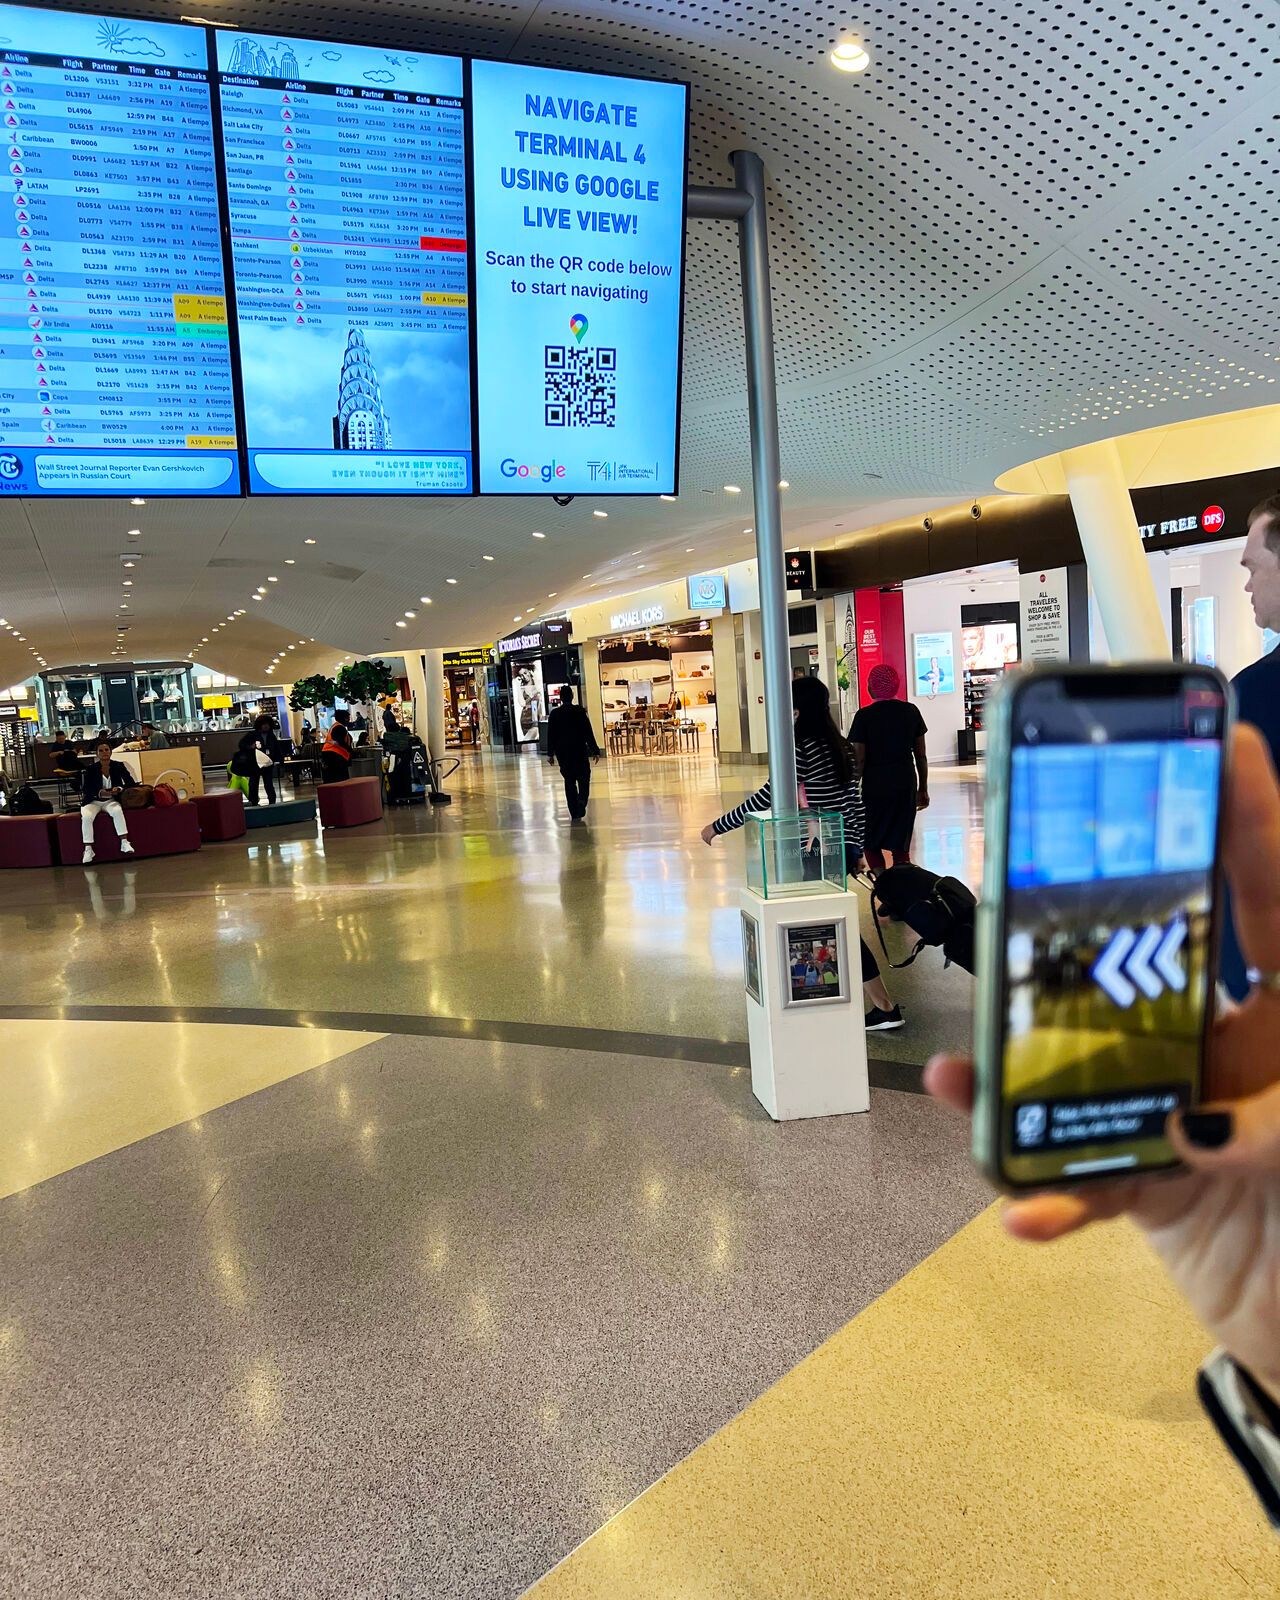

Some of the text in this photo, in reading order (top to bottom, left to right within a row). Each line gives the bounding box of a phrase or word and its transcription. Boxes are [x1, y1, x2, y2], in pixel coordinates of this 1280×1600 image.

[5, 54, 207, 80] Airline Flight Partner Time Gate Remarks
[15, 70, 33, 78] Delta
[185, 86, 207, 94] tiempo
[17, 86, 34, 94] Delta
[186, 102, 208, 110] tiempo
[221, 90, 243, 98] Raleigh
[223, 76, 461, 107] Destination Airline Flight Partner Time Gate Remarks
[526, 94, 638, 127] NAVIGATE
[252, 123, 263, 131] City
[22, 135, 54, 144] Caribbean
[190, 149, 212, 157] tiempo
[237, 138, 265, 146] Francisco
[515, 131, 646, 164] TERMINAL 4
[238, 153, 255, 161] Juan,
[227, 167, 253, 175] Santiago
[229, 182, 271, 191] Santo Domingo
[501, 167, 659, 201] USING GOOGLE
[524, 206, 638, 234] LIVE VIEW!
[486, 251, 672, 276] Scan the QR code below
[511, 280, 649, 303] to start navigating
[56, 464, 78, 472] Street
[80, 464, 108, 472] Journal
[332, 470, 356, 478] EVEN
[388, 461, 410, 469] LOVE
[436, 462, 463, 470] YORK,
[501, 458, 566, 483] Google
[587, 462, 612, 480] T4
[1160, 516, 1198, 535] FREE
[1204, 513, 1221, 526] DFS
[1028, 605, 1053, 614] WELCOME
[1030, 598, 1058, 606] TRAVELERS
[610, 606, 664, 630] MICHAEL KORS
[522, 634, 540, 649] SECRET
